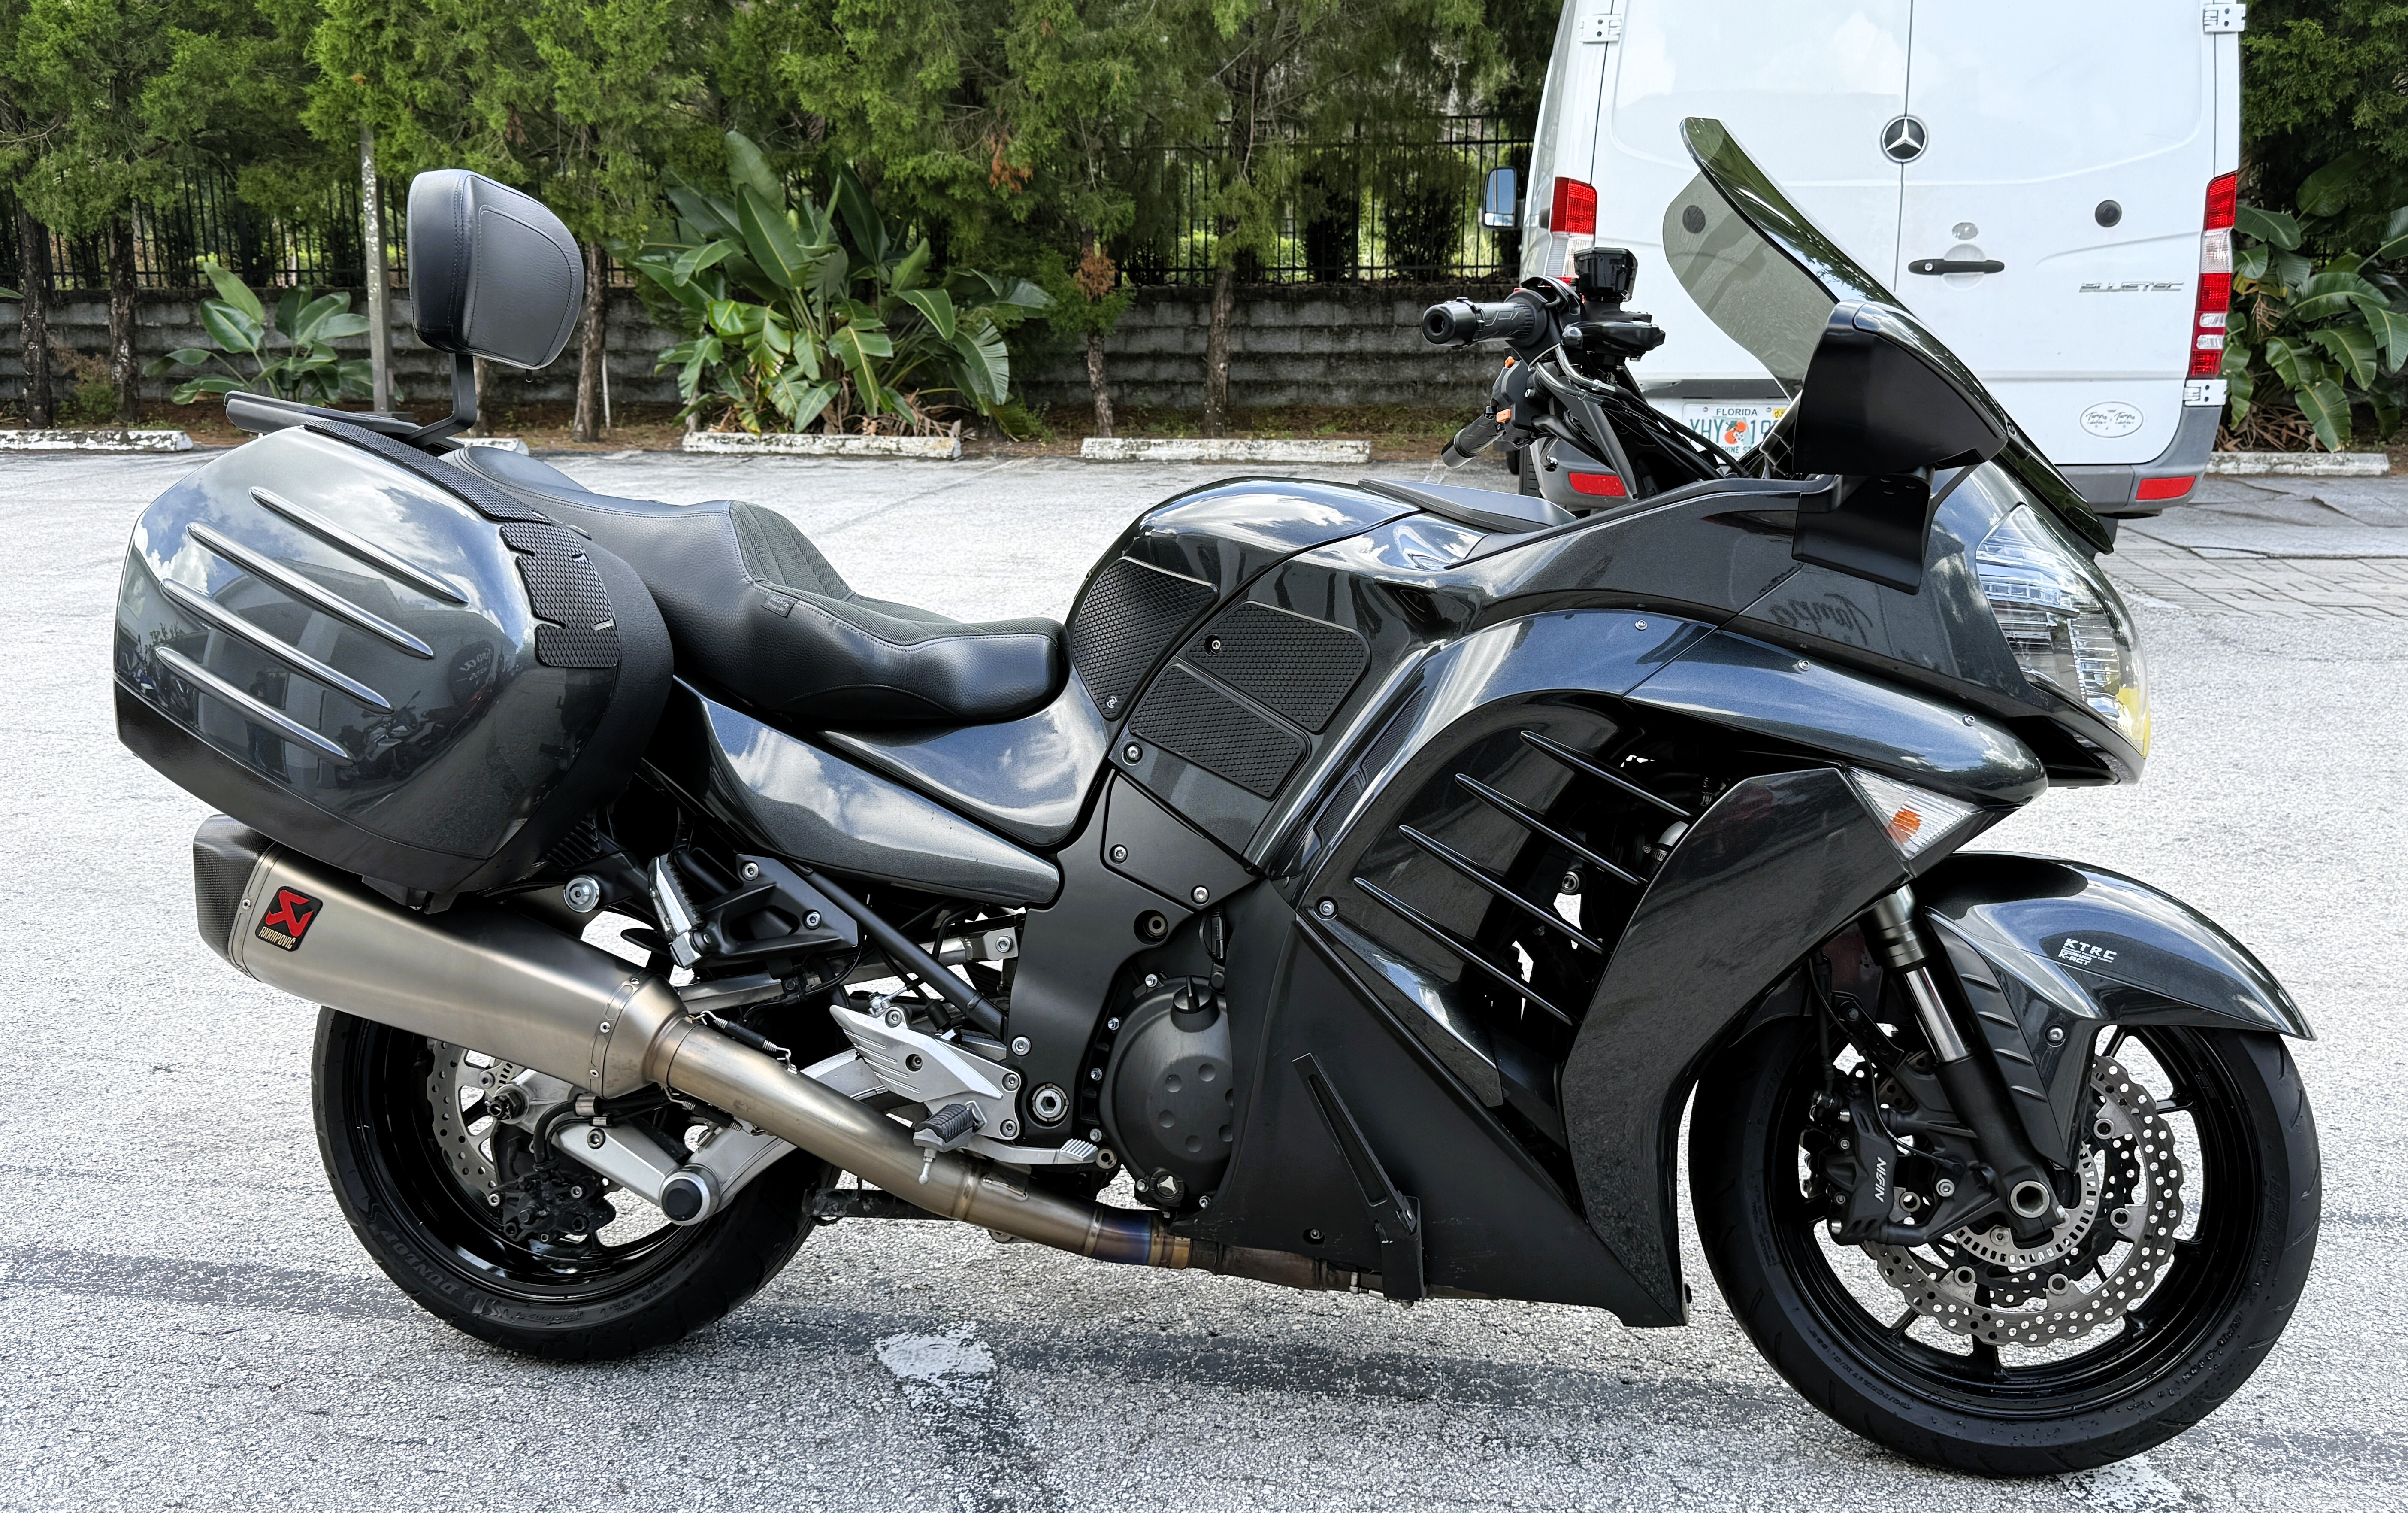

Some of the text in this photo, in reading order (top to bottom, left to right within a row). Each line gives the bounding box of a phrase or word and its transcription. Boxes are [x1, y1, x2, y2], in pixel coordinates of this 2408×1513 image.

[1716, 408, 1758, 416] FLORIDA
[2058, 951, 2091, 965] K-ACT
[2064, 938, 2117, 961] KTRC
[380, 1230, 460, 1295] DUNLOP
